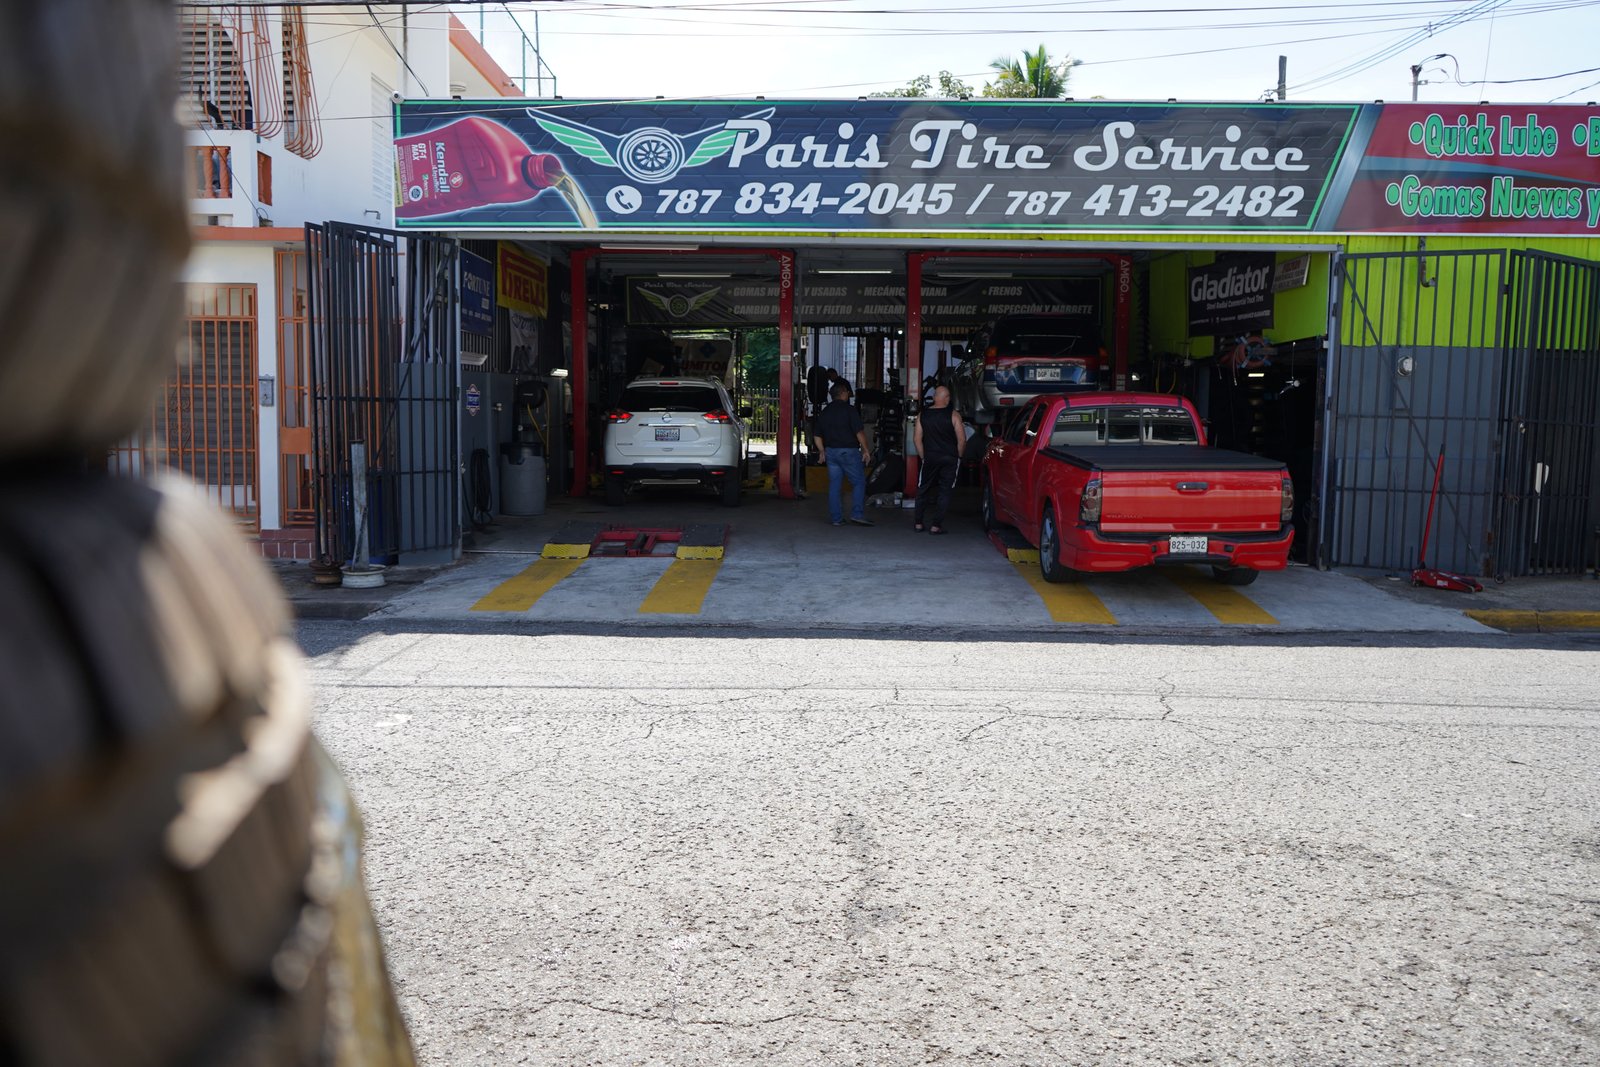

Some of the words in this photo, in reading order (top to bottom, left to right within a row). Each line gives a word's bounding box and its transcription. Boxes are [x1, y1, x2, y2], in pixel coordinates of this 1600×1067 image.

[1423, 112, 1495, 157] Quick
[1500, 113, 1558, 157] Lube
[411, 144, 420, 161] MAX
[417, 142, 427, 160] GT-1
[724, 119, 889, 169] Paris
[909, 119, 1051, 170] Tire
[1073, 121, 1311, 172] Service
[435, 142, 450, 193] Kendall
[656, 189, 722, 215] 787
[734, 182, 957, 216] 834-2045
[1004, 190, 1072, 217] 787
[1082, 184, 1305, 217] 413-2482
[1400, 175, 1486, 217] Gomas
[1490, 175, 1581, 218] Nuevas
[781, 254, 792, 289] AMGO
[1119, 258, 1130, 293] AMGO
[733, 287, 766, 297] GOMAS
[811, 286, 848, 297] USADAS
[863, 284, 906, 297] MECÁNIC
[920, 286, 947, 297] VIANA
[988, 286, 1024, 297] FRENOS
[1190, 264, 1271, 304] Gladiator
[733, 304, 770, 315] CAMBIO
[823, 304, 853, 315] FILTRO
[936, 304, 978, 315] BALANCE
[1171, 540, 1206, 550] 825-032
